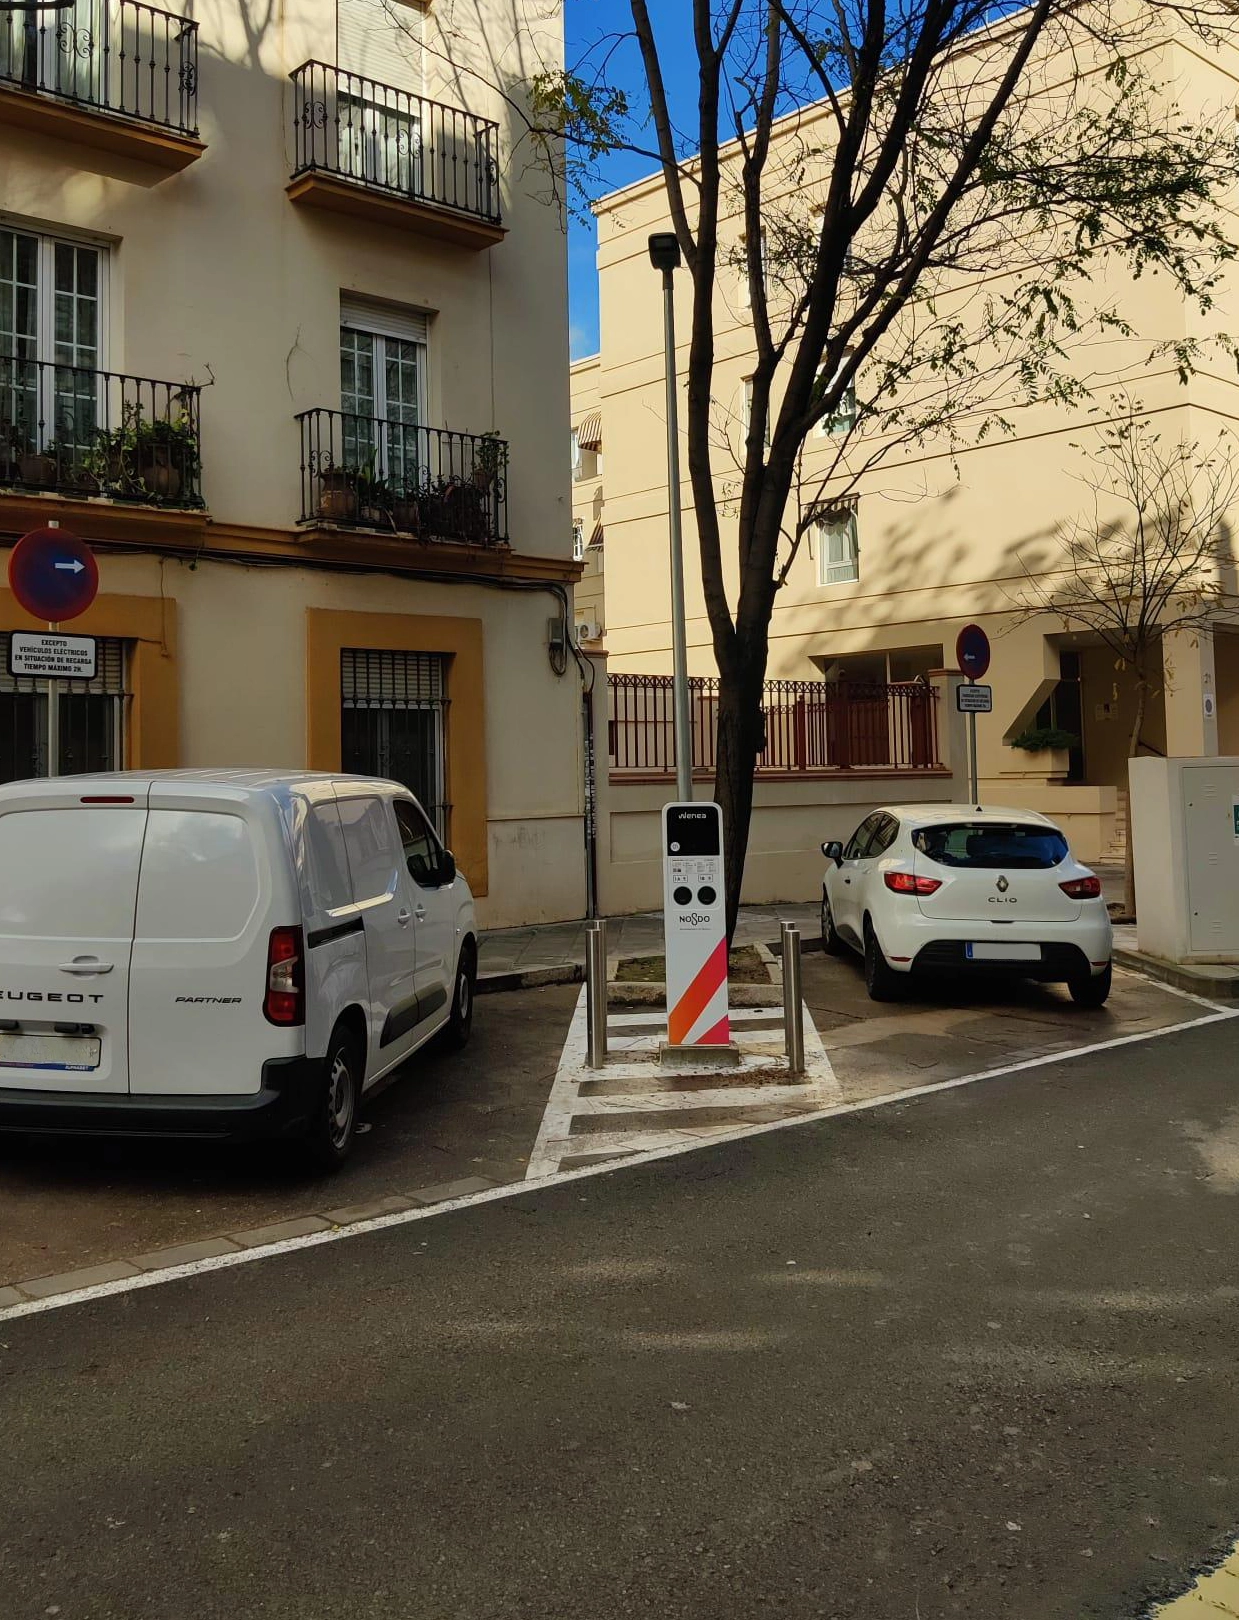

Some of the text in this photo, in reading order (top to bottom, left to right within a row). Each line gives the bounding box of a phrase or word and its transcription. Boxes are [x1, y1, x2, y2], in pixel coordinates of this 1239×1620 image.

[19, 646, 52, 654] VEHÍCULOS
[0, 990, 104, 1004] UGEOT
[175, 996, 242, 1004] PARTNER
